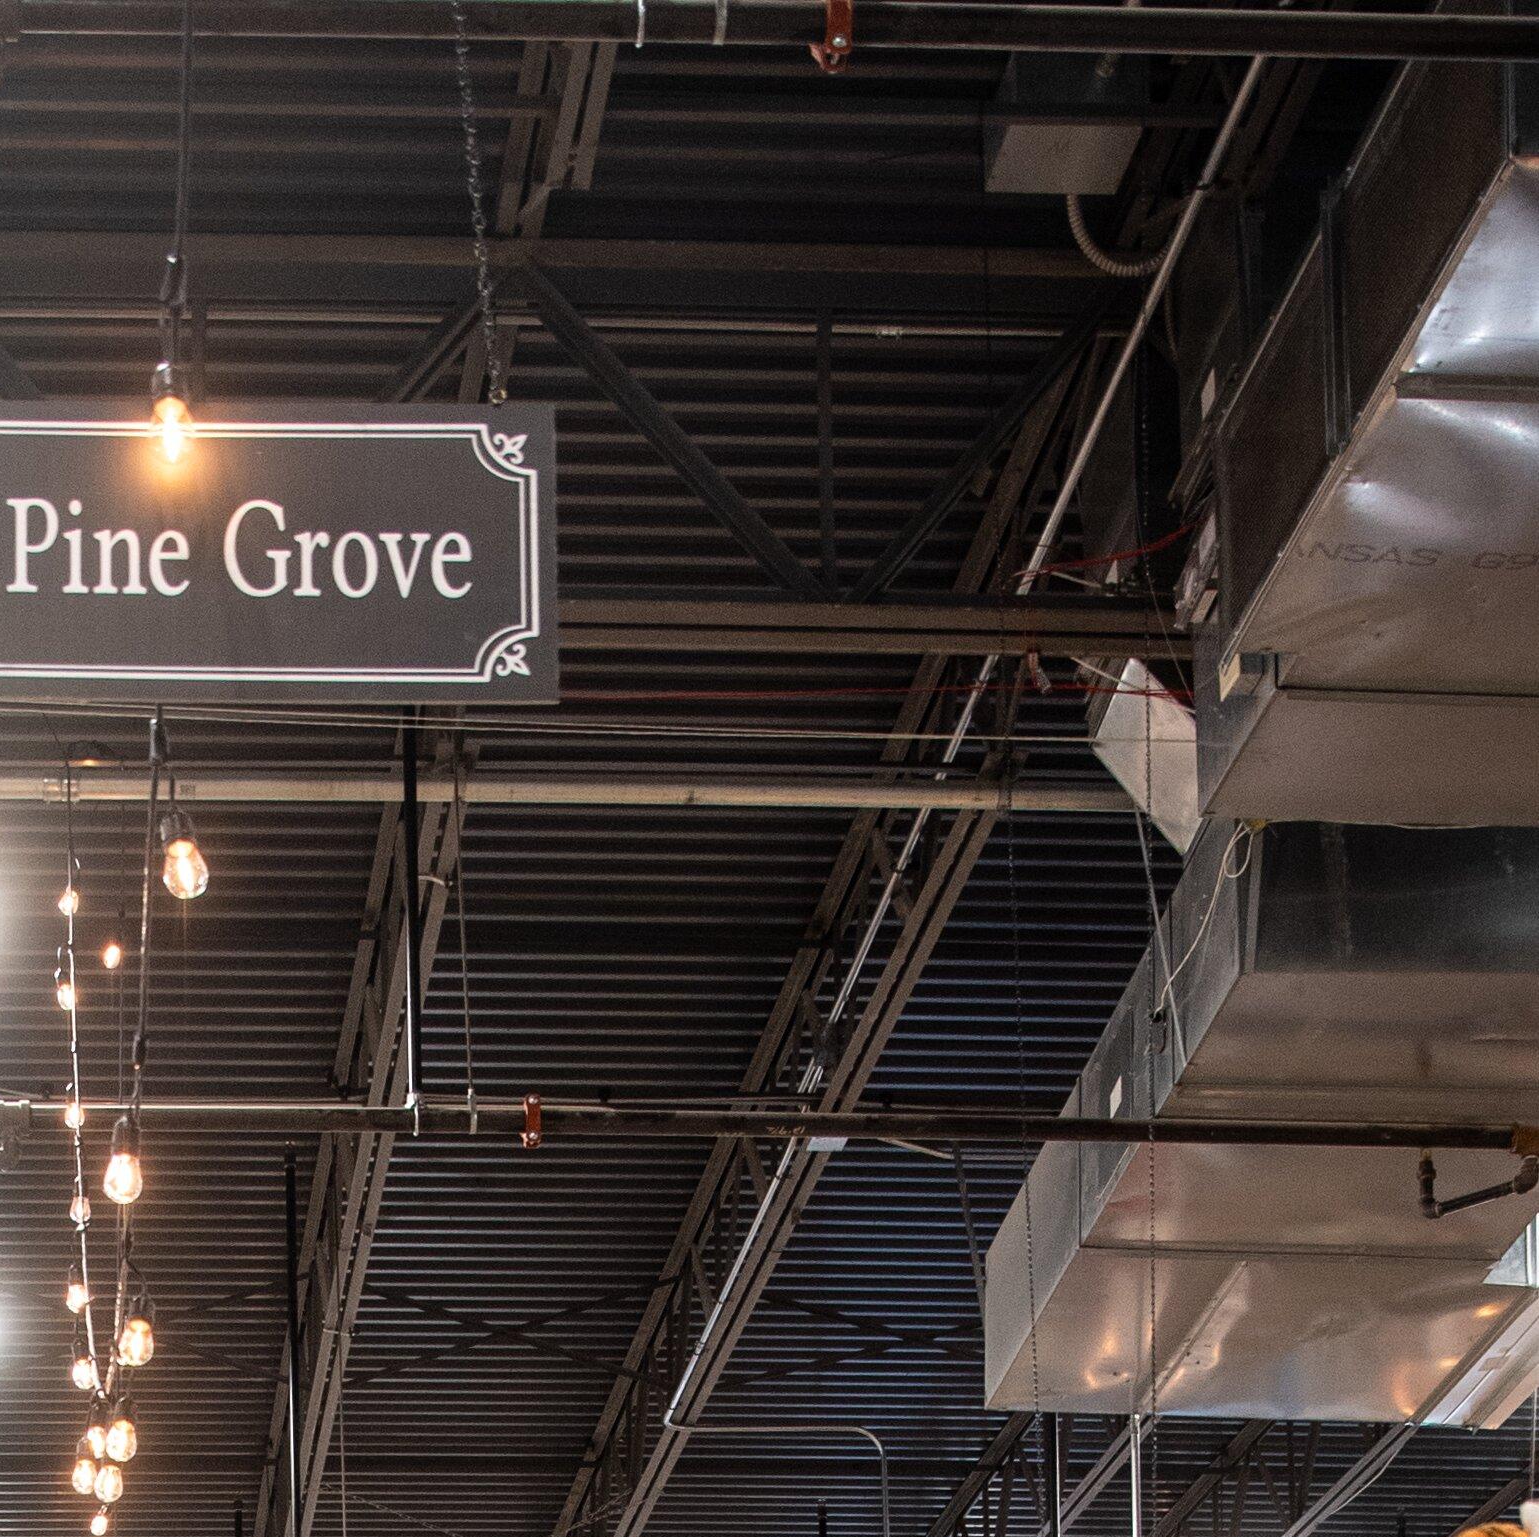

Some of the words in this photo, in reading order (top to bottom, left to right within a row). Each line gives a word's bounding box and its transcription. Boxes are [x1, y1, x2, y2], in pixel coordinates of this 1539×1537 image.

[5, 497, 190, 597] Pine
[223, 499, 473, 600] Grove
[1297, 541, 1442, 566] NSAS
